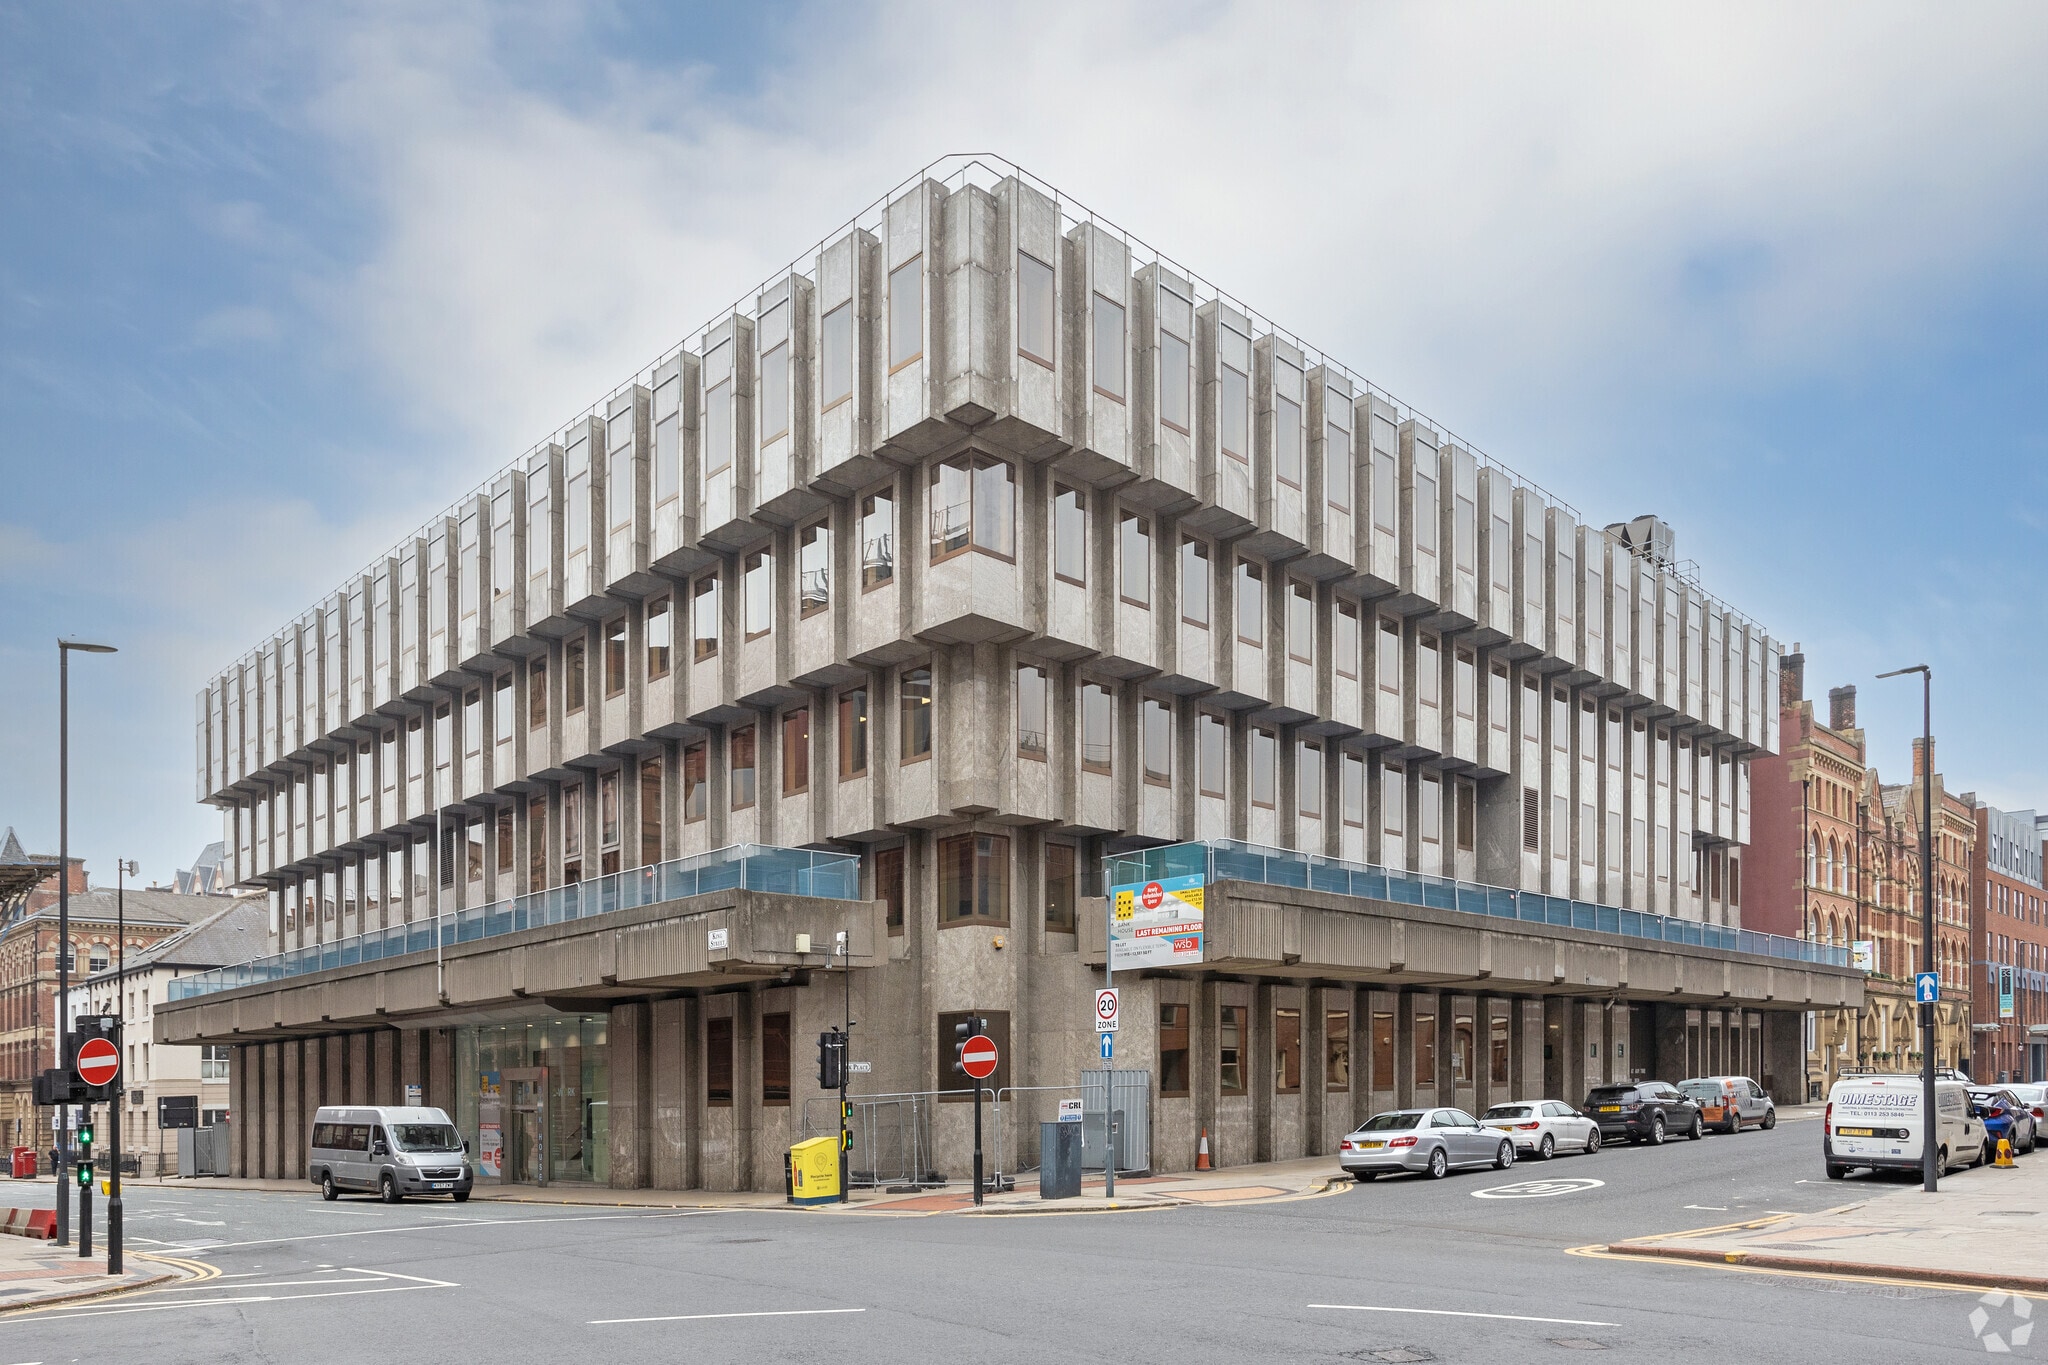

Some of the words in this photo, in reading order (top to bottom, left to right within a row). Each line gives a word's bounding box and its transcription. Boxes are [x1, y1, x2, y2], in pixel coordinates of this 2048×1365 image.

[1152, 925, 1182, 935] REMAINING
[1184, 923, 1203, 931] FLOOR
[1175, 938, 1192, 949] wsb
[1100, 1000, 1114, 1011] 20
[1098, 1020, 1116, 1028] ZONE
[1069, 1101, 1081, 1109] CRL
[1839, 1093, 1918, 1107] DIMESTAGE
